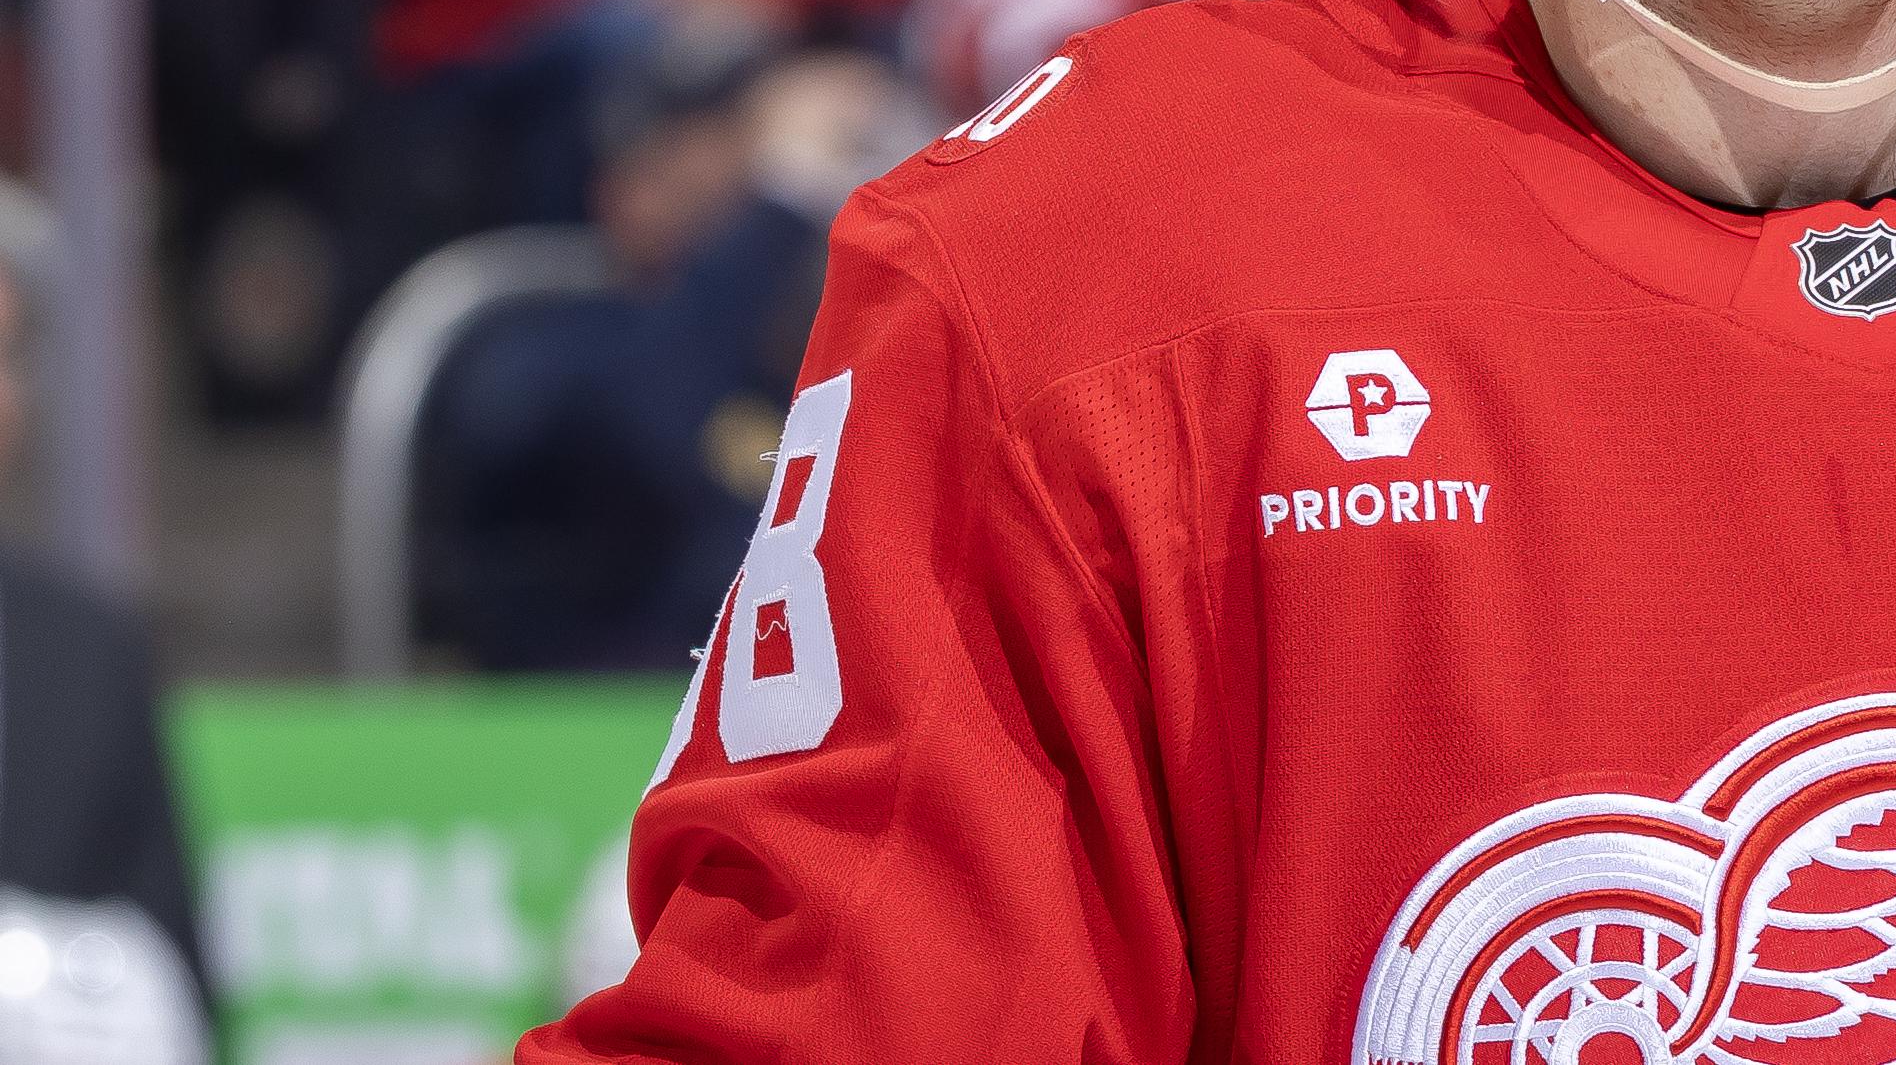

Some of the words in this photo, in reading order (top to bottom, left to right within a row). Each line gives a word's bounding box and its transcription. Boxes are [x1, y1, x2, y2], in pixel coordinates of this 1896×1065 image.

[1826, 244, 1889, 300] NHL
[1260, 479, 1491, 538] PRIORITY
[642, 369, 852, 798] 8
